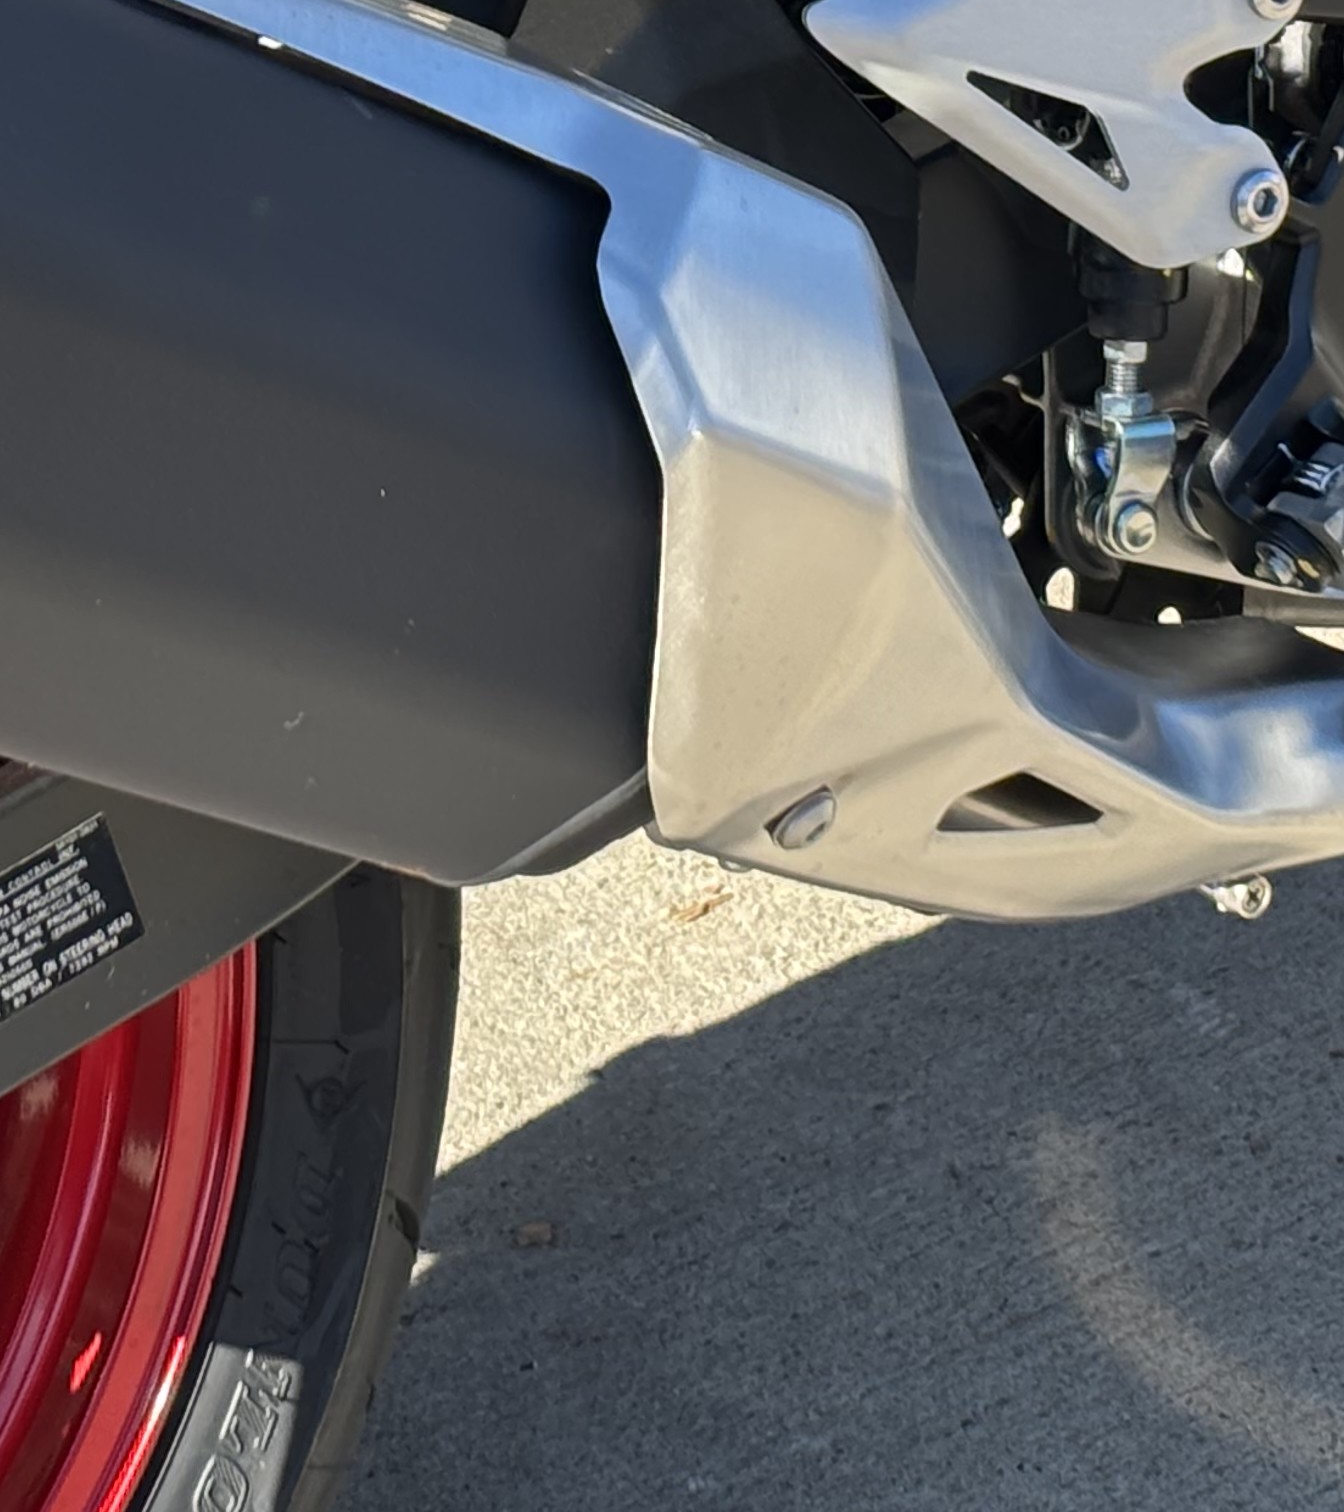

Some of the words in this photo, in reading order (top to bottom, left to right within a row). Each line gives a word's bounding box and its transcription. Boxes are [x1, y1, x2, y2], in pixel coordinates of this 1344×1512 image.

[8, 856, 51, 891] CONTROL
[14, 884, 38, 908] NOISE
[46, 856, 85, 889] EMISSION
[0, 908, 20, 930] TEST
[12, 891, 70, 936] MOTORCYCLE
[78, 880, 88, 896] TO
[24, 924, 40, 943] ARE
[47, 888, 98, 929] PROHIBITED
[3, 967, 37, 1001] NUMBER
[44, 956, 55, 977] ON
[60, 927, 104, 967] STEERING
[108, 910, 131, 937] HEAD
